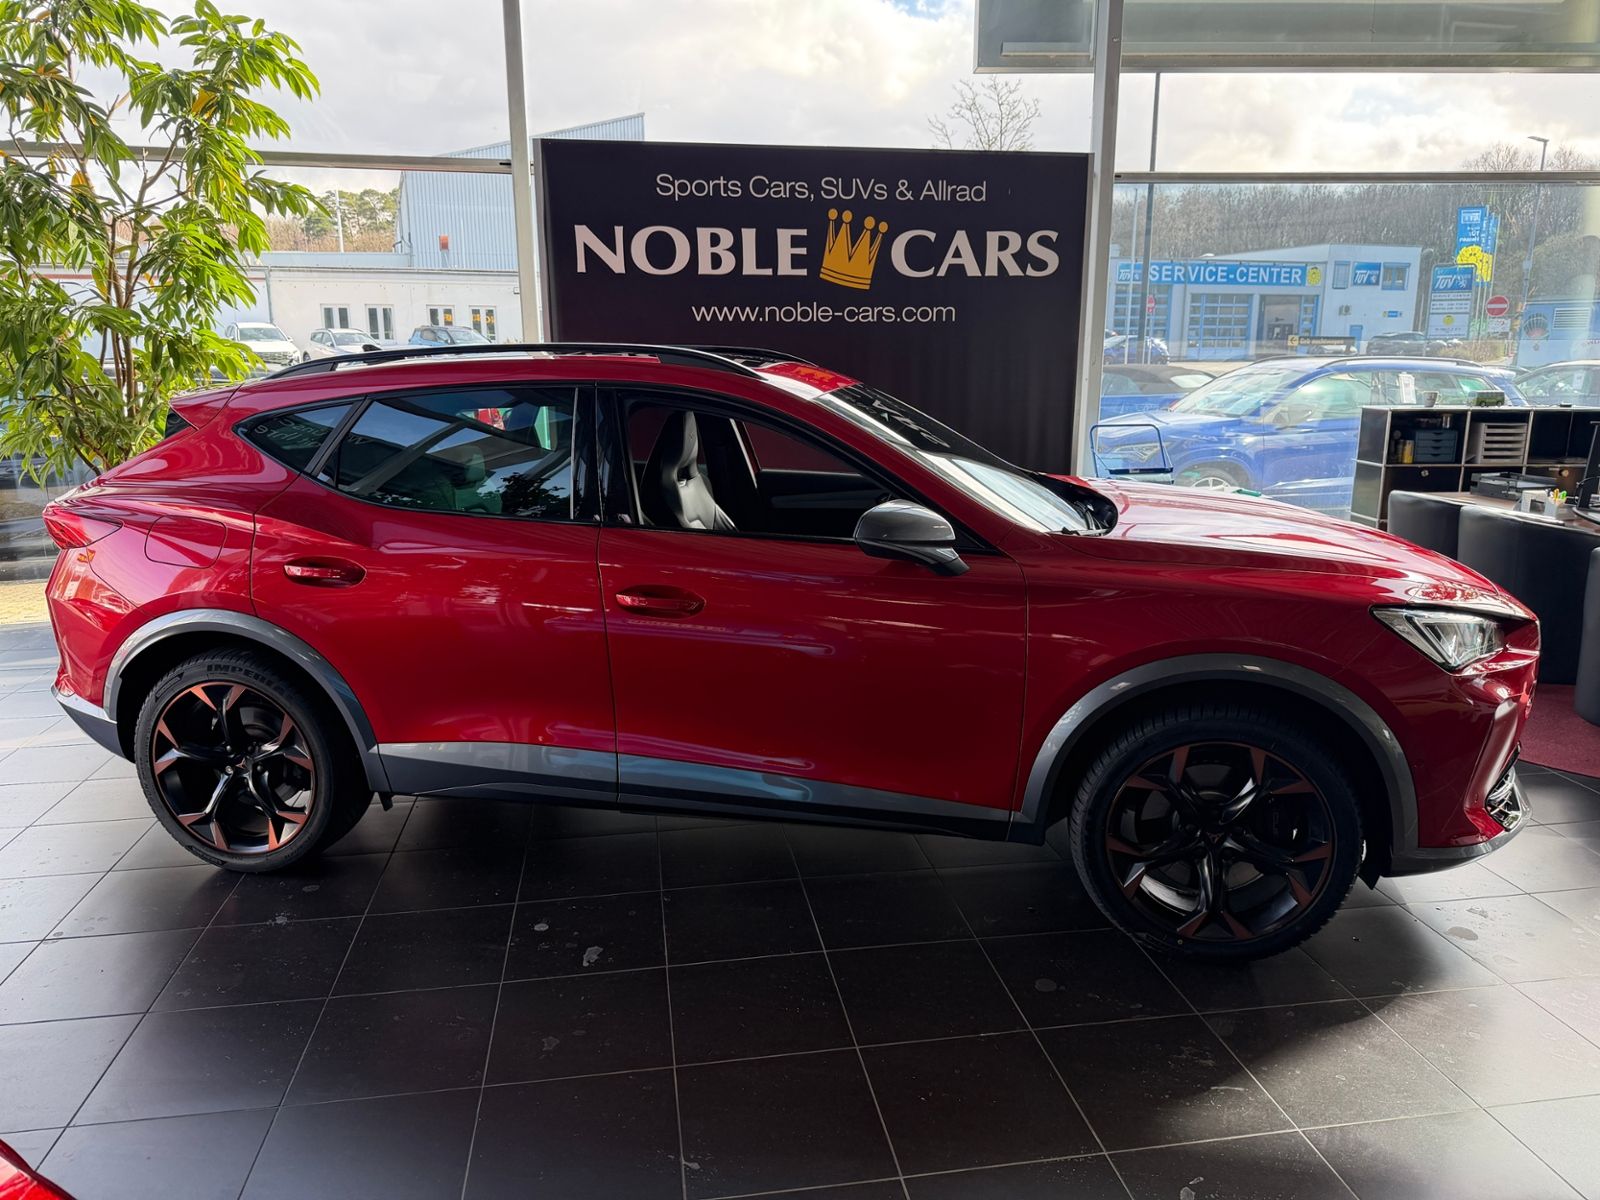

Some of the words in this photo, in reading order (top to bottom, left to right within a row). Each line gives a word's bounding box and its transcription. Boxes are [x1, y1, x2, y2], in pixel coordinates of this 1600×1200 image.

[656, 173, 742, 201] Sports
[749, 175, 814, 202] Cars,
[820, 176, 888, 201] SUVs
[895, 179, 914, 201] &
[919, 179, 987, 202] Allrad
[574, 224, 808, 276] NOBLE
[890, 229, 1060, 278] CARS
[1149, 265, 1301, 284] SERVICE-CENTER
[691, 301, 956, 323] www.noble-cars.com
